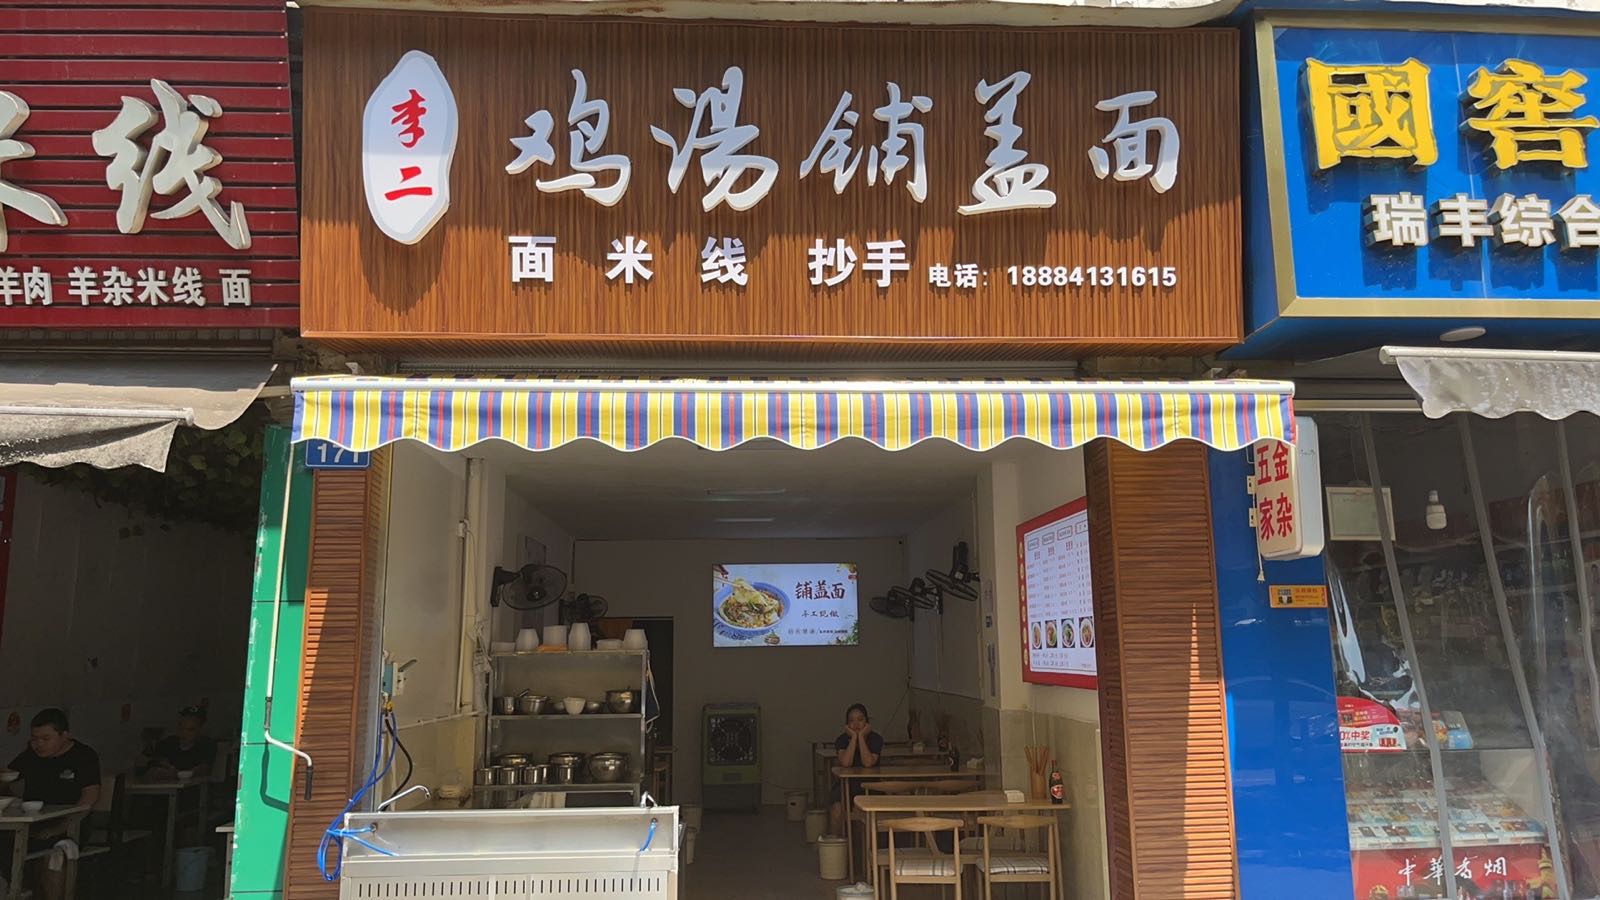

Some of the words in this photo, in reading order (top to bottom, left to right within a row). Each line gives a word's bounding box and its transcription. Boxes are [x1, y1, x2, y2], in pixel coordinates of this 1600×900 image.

[384, 89, 433, 201] 李二
[1367, 192, 1600, 248] 瑞丰综合
[67, 265, 207, 307] 羊杂米线
[218, 268, 252, 306] 面
[807, 238, 911, 288] 抄手
[1006, 265, 1178, 288] 18884131615
